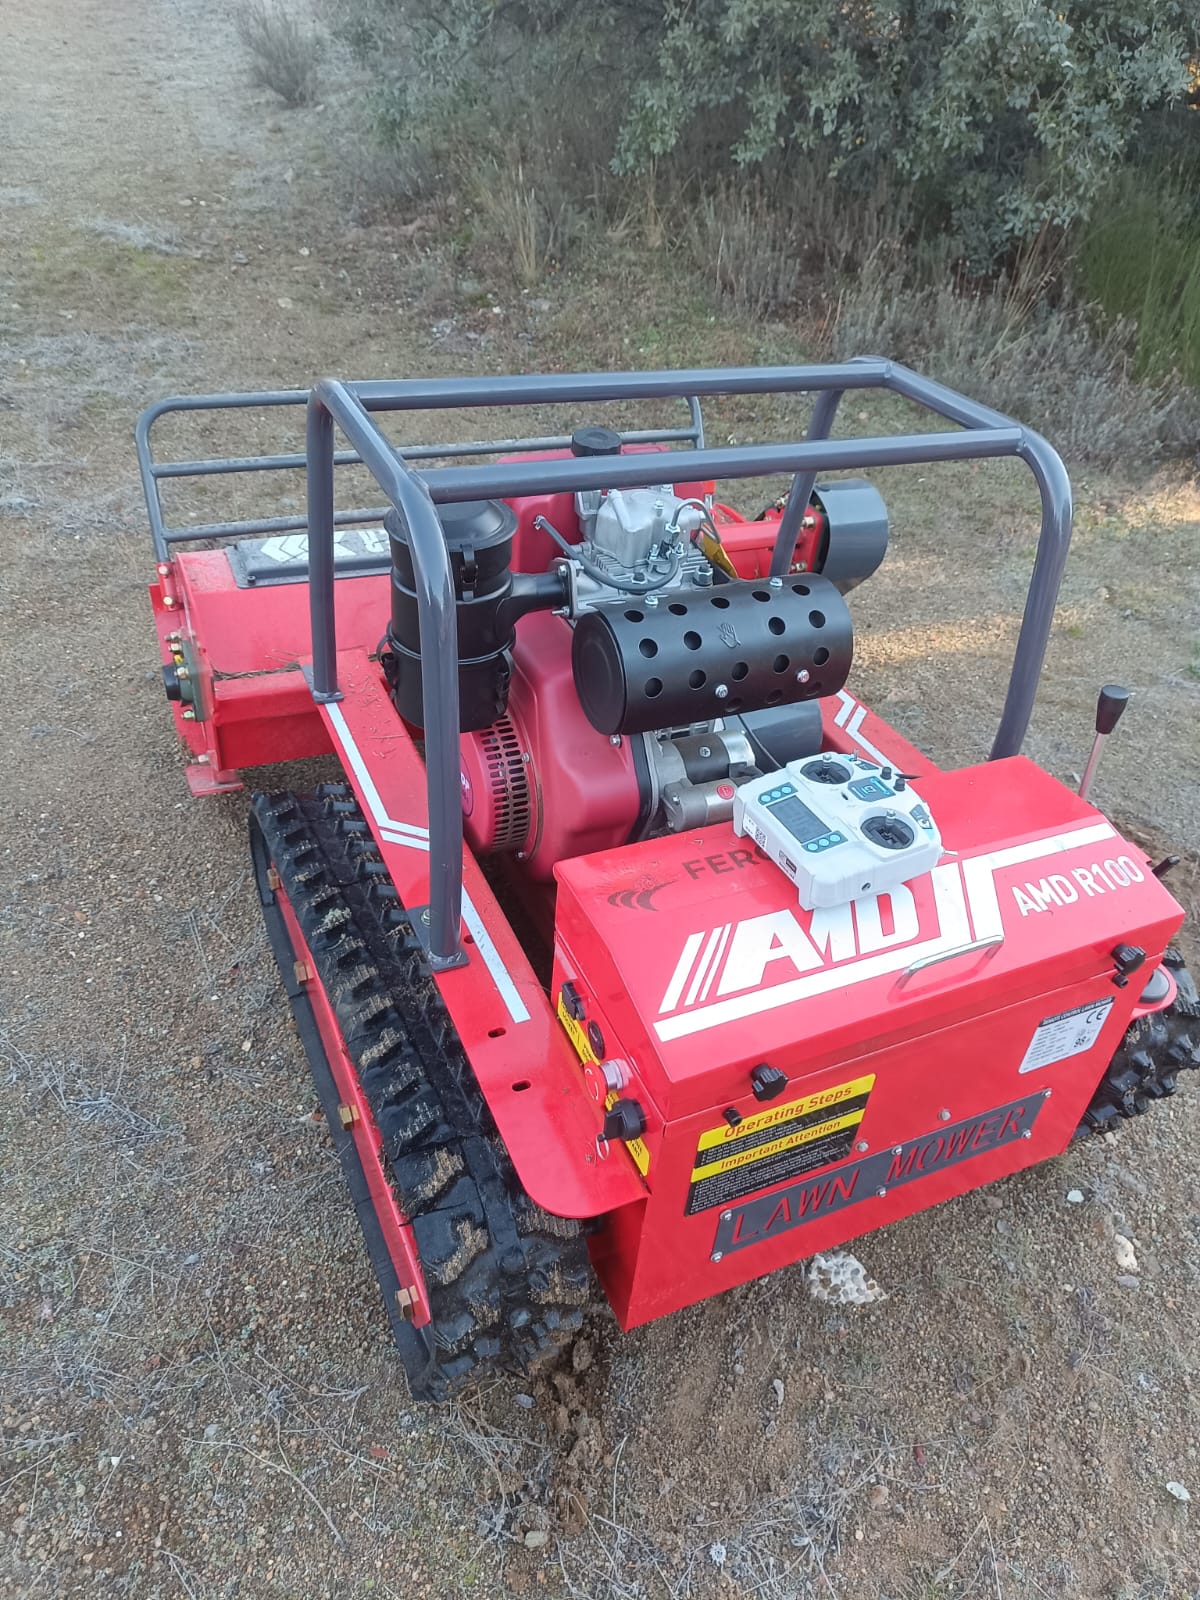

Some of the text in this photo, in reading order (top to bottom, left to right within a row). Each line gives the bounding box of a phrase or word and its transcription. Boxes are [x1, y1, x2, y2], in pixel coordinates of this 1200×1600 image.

[1011, 855, 1145, 917] AMD R100
[723, 1102, 805, 1139] Operating
[808, 1086, 853, 1109] Steps
[720, 1141, 784, 1170] Important
[786, 1120, 841, 1146] Attention
[731, 1168, 860, 1244] LAWN
[886, 1105, 1027, 1184] MOWER
